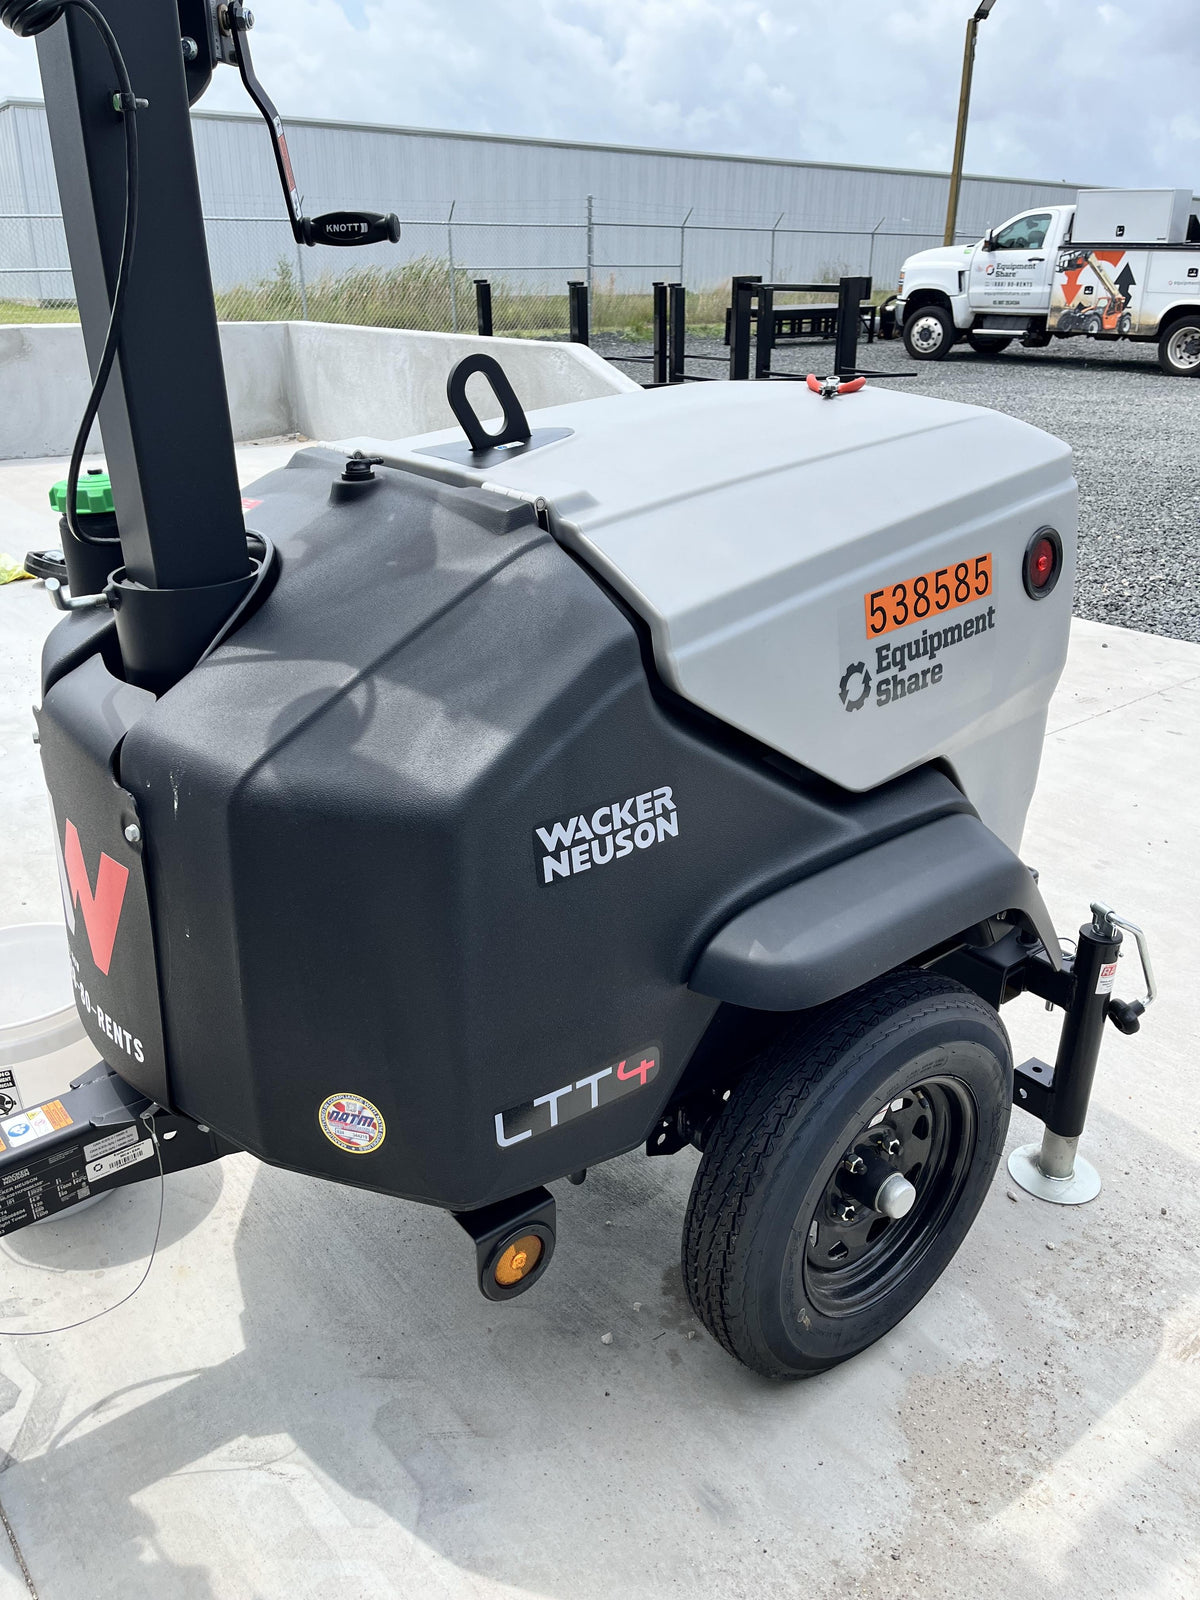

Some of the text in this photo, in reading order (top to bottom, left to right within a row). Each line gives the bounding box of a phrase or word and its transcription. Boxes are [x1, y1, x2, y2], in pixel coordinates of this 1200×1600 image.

[326, 223, 359, 233] KNOTT
[996, 263, 1037, 271] Equipment
[870, 555, 989, 634] 538585
[876, 606, 996, 675] Equipment
[876, 663, 943, 707] Share
[535, 786, 677, 852] WACKER
[542, 810, 679, 884] NEUSON
[494, 1058, 655, 1147] LTT4
